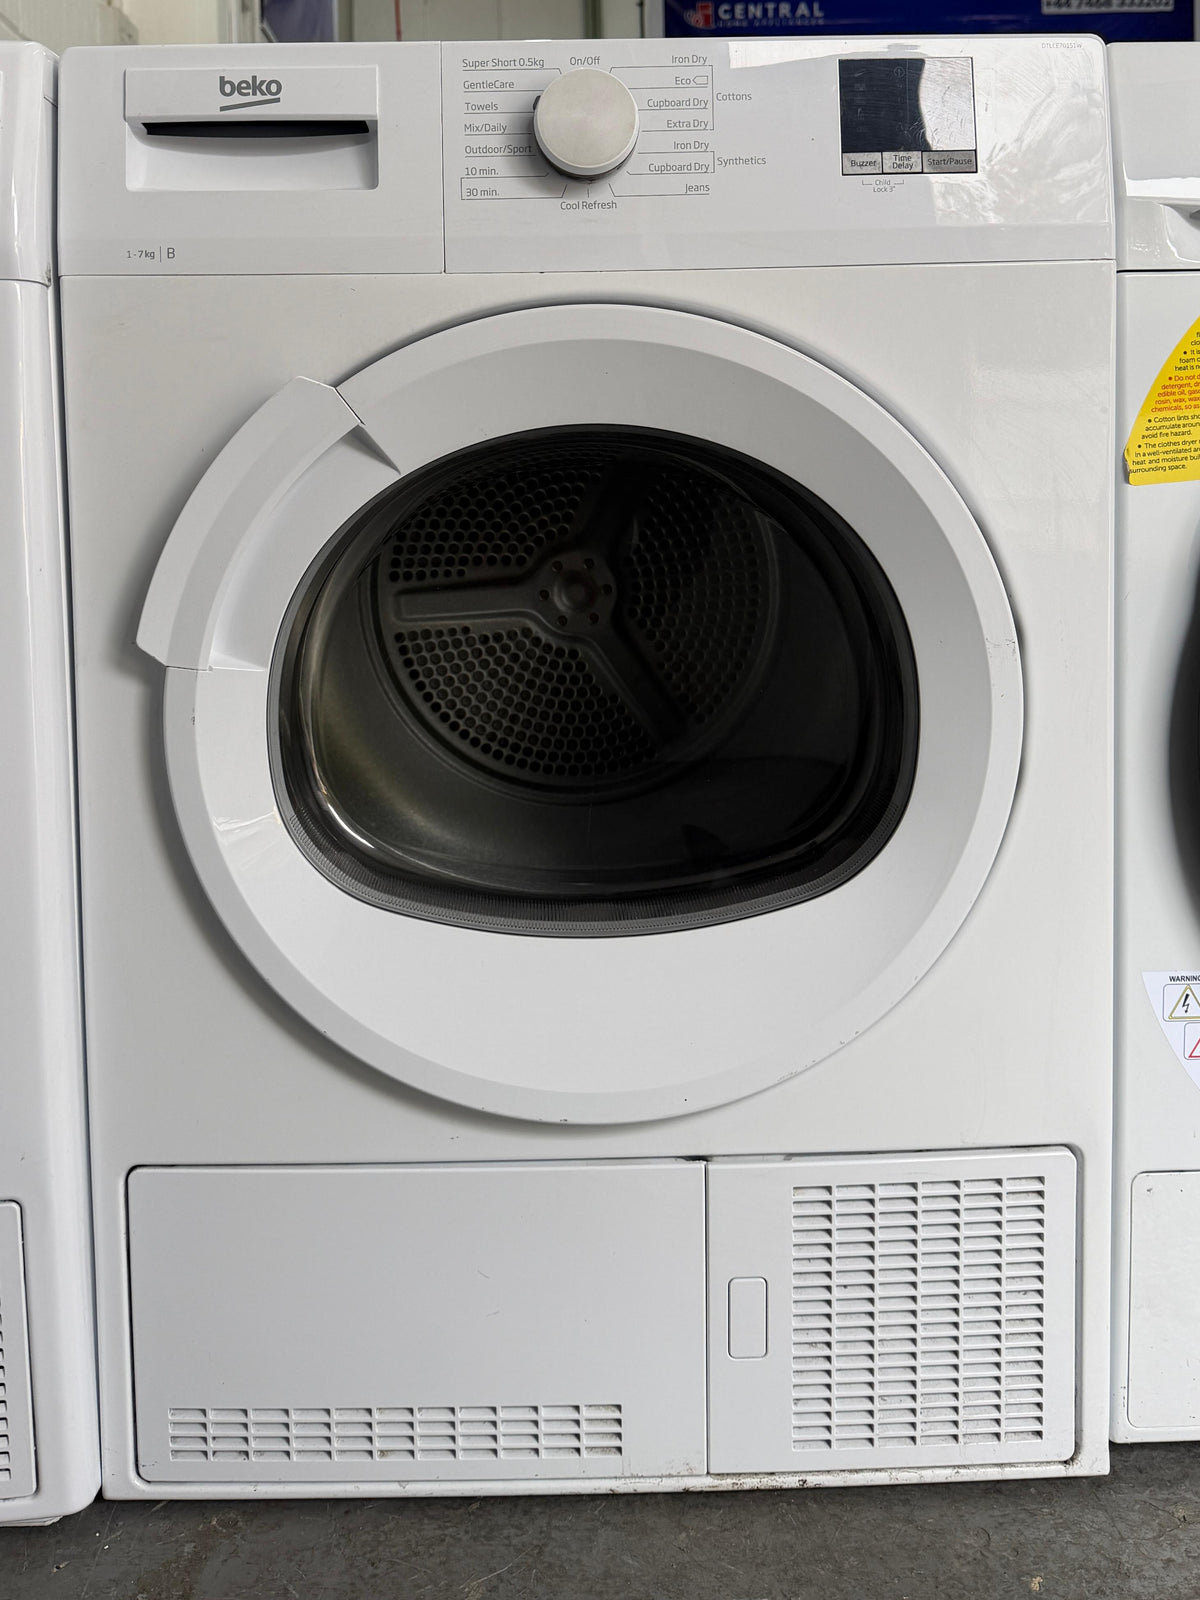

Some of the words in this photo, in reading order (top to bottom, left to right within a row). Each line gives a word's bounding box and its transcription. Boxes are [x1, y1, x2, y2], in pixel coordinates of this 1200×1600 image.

[718, 2, 824, 19] CENTRAL
[462, 58, 489, 68] Super
[491, 58, 517, 67] Short
[518, 57, 545, 68] 0.5kg
[569, 56, 601, 66] On/Off
[671, 55, 689, 64] Iron
[690, 54, 708, 65] Dry
[219, 75, 282, 97] beko
[463, 79, 515, 89] GentleCare
[675, 77, 691, 86] Eco
[716, 92, 753, 101] Cottons
[465, 102, 499, 111] Towels
[647, 98, 691, 109] Cupboard
[693, 98, 709, 109] Dry
[464, 123, 507, 134] Mix/Daily
[667, 119, 690, 129] Extra
[691, 119, 709, 130] Dry
[465, 144, 532, 155] Outdoor/Sport
[673, 141, 691, 150] Iron
[693, 140, 710, 151] Dry
[717, 156, 767, 168] Synthetics
[893, 154, 912, 162] Time
[927, 157, 973, 166] Start/Pause
[465, 167, 477, 176] 10
[479, 166, 499, 176] min.
[648, 162, 691, 173] Cupboard
[693, 162, 710, 173] Dry
[892, 162, 914, 170] Delay
[466, 188, 478, 197] 30
[480, 187, 500, 197] min.
[685, 183, 710, 193] Jeans
[560, 201, 580, 210] Cool
[582, 200, 617, 210] Refresh
[167, 247, 176, 259] B
[1161, 382, 1192, 390] detergent,
[1157, 390, 1176, 398] edible
[1150, 404, 1183, 413] chemicals,
[1145, 423, 1181, 432] accumulate
[1170, 429, 1192, 437] hazard.
[1157, 440, 1181, 448] clothes
[1147, 447, 1192, 456] well-ventilated
[1129, 465, 1167, 474] surrounding
[1167, 463, 1187, 471] space.
